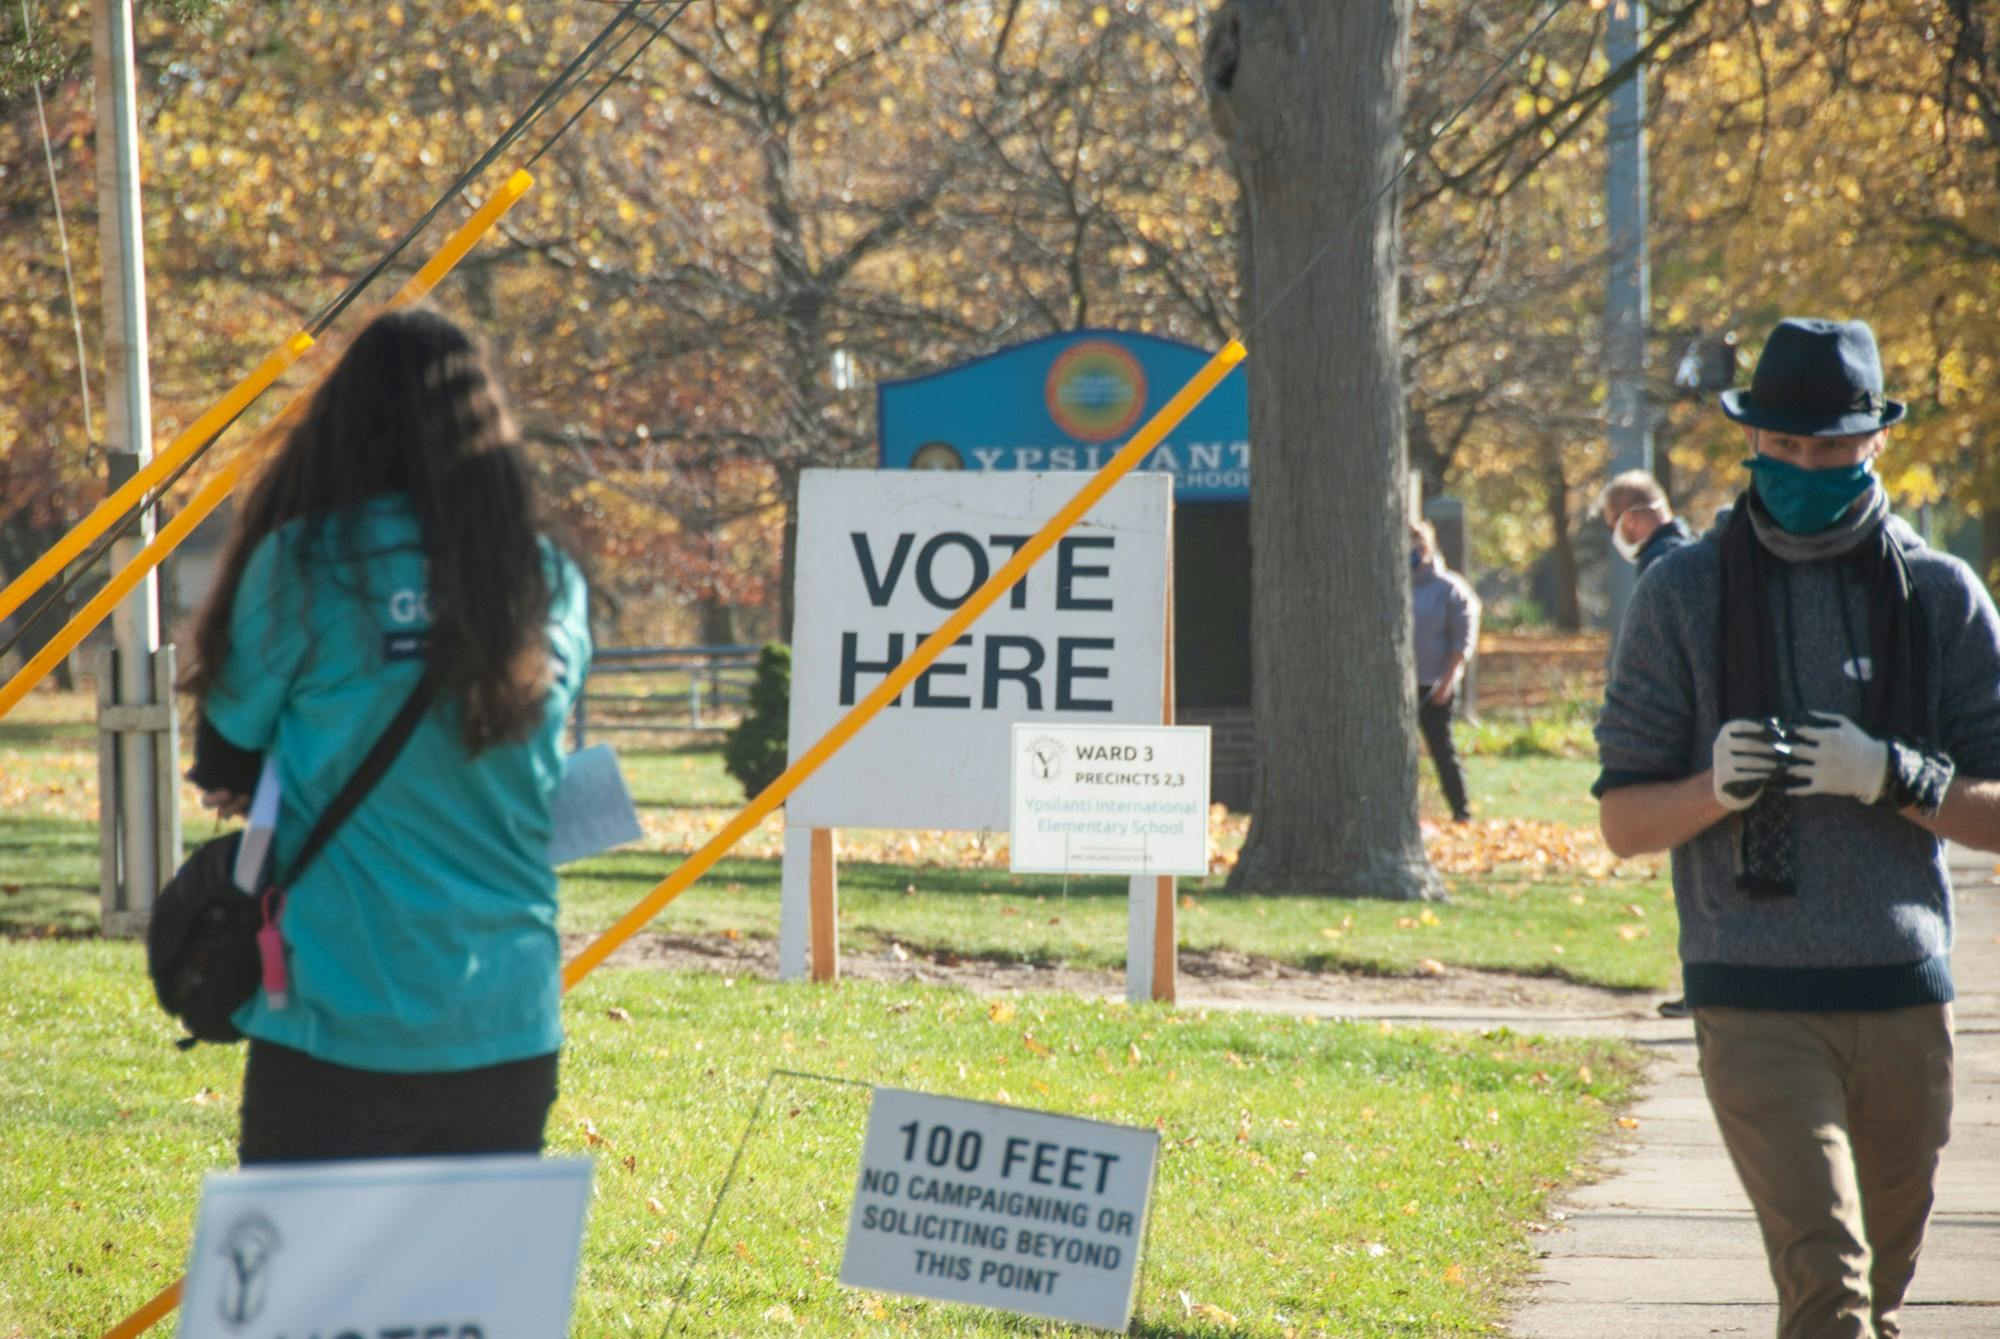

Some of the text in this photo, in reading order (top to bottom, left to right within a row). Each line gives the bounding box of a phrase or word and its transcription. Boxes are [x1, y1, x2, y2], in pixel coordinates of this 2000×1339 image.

[850, 531, 1115, 611] VOTE
[839, 632, 1115, 712] HERE
[1075, 745, 1154, 763] WARD 3
[1075, 772, 1185, 788] PRECINCTS 2,3
[1025, 797, 1197, 815] Ypsilanti International
[1038, 818, 1184, 836] Elementary School
[899, 1120, 1120, 1194] 100 FEET
[861, 1169, 1134, 1237] NO CAMPAIGNING OR
[862, 1205, 1121, 1271] SOLICITING BEYOND
[914, 1249, 1060, 1296] THIS POINT
